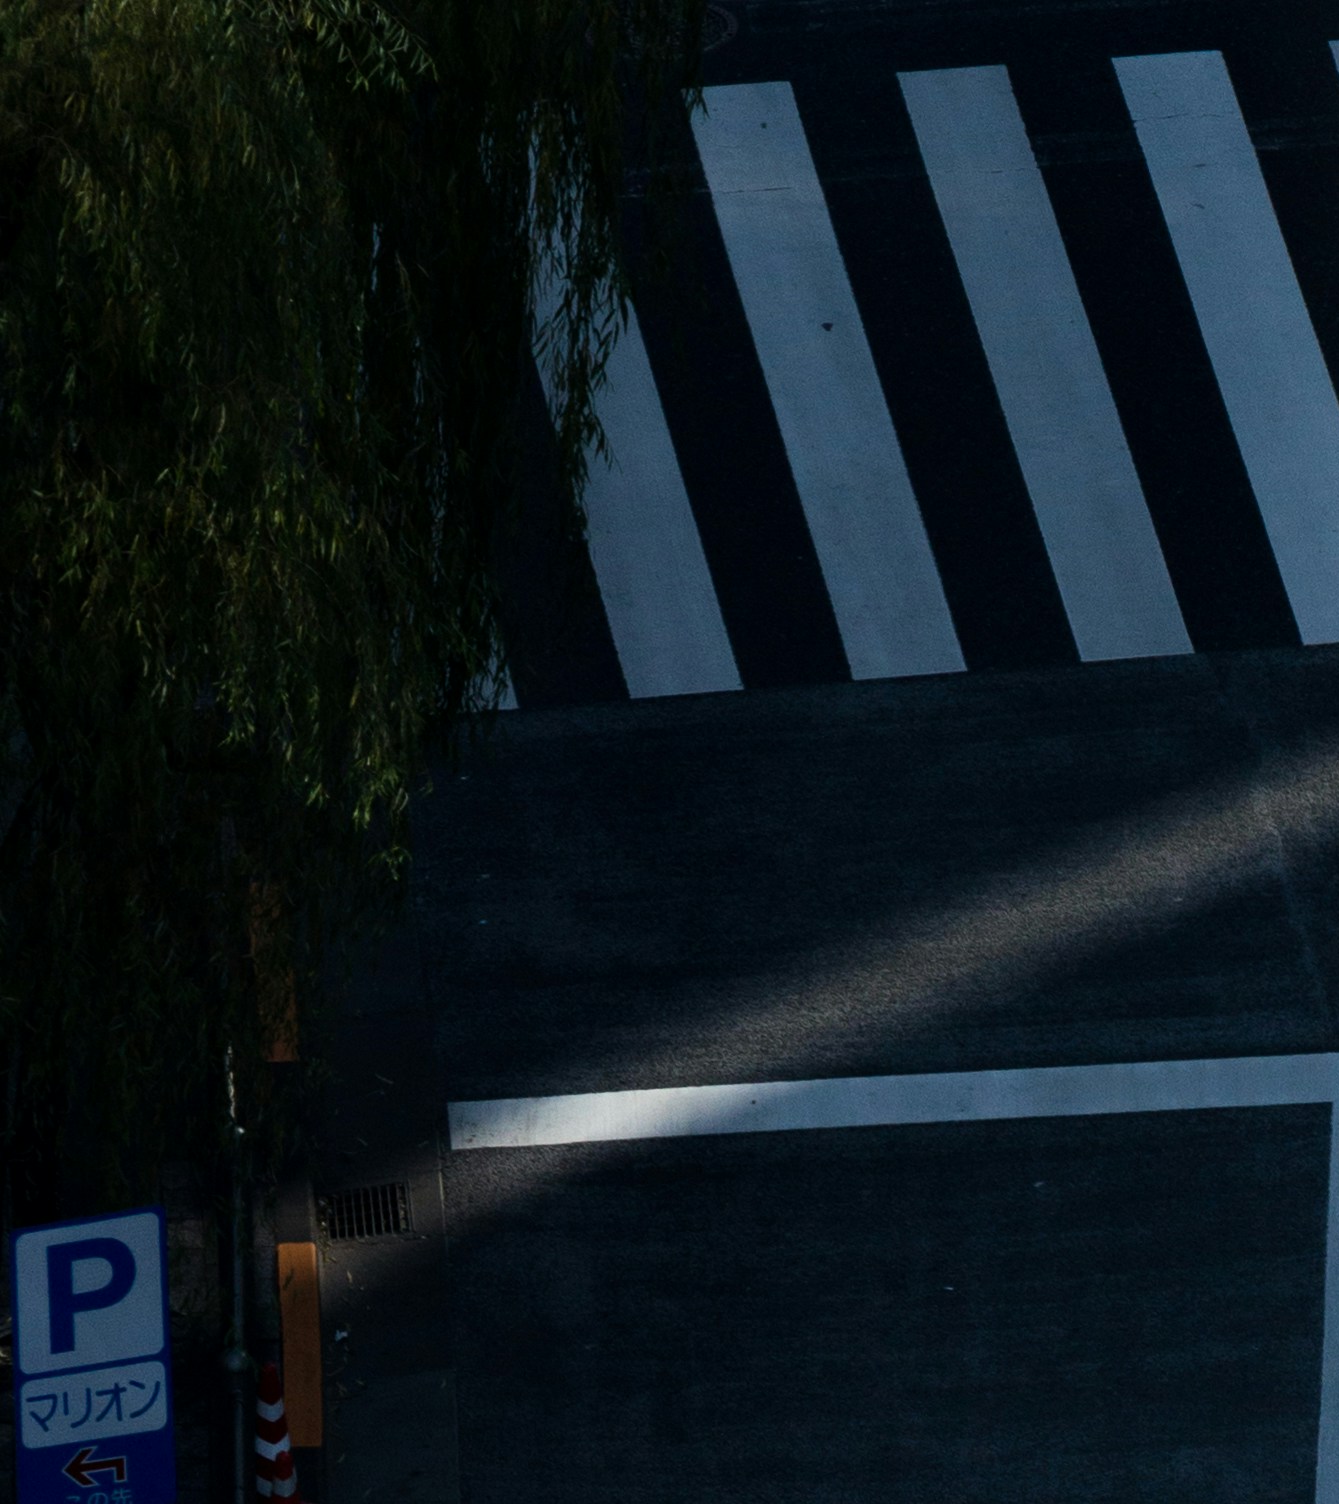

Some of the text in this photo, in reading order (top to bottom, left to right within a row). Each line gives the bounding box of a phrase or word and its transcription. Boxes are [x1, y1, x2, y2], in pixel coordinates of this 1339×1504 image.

[47, 1237, 138, 1355] P
[26, 1380, 161, 1433] マリオン
